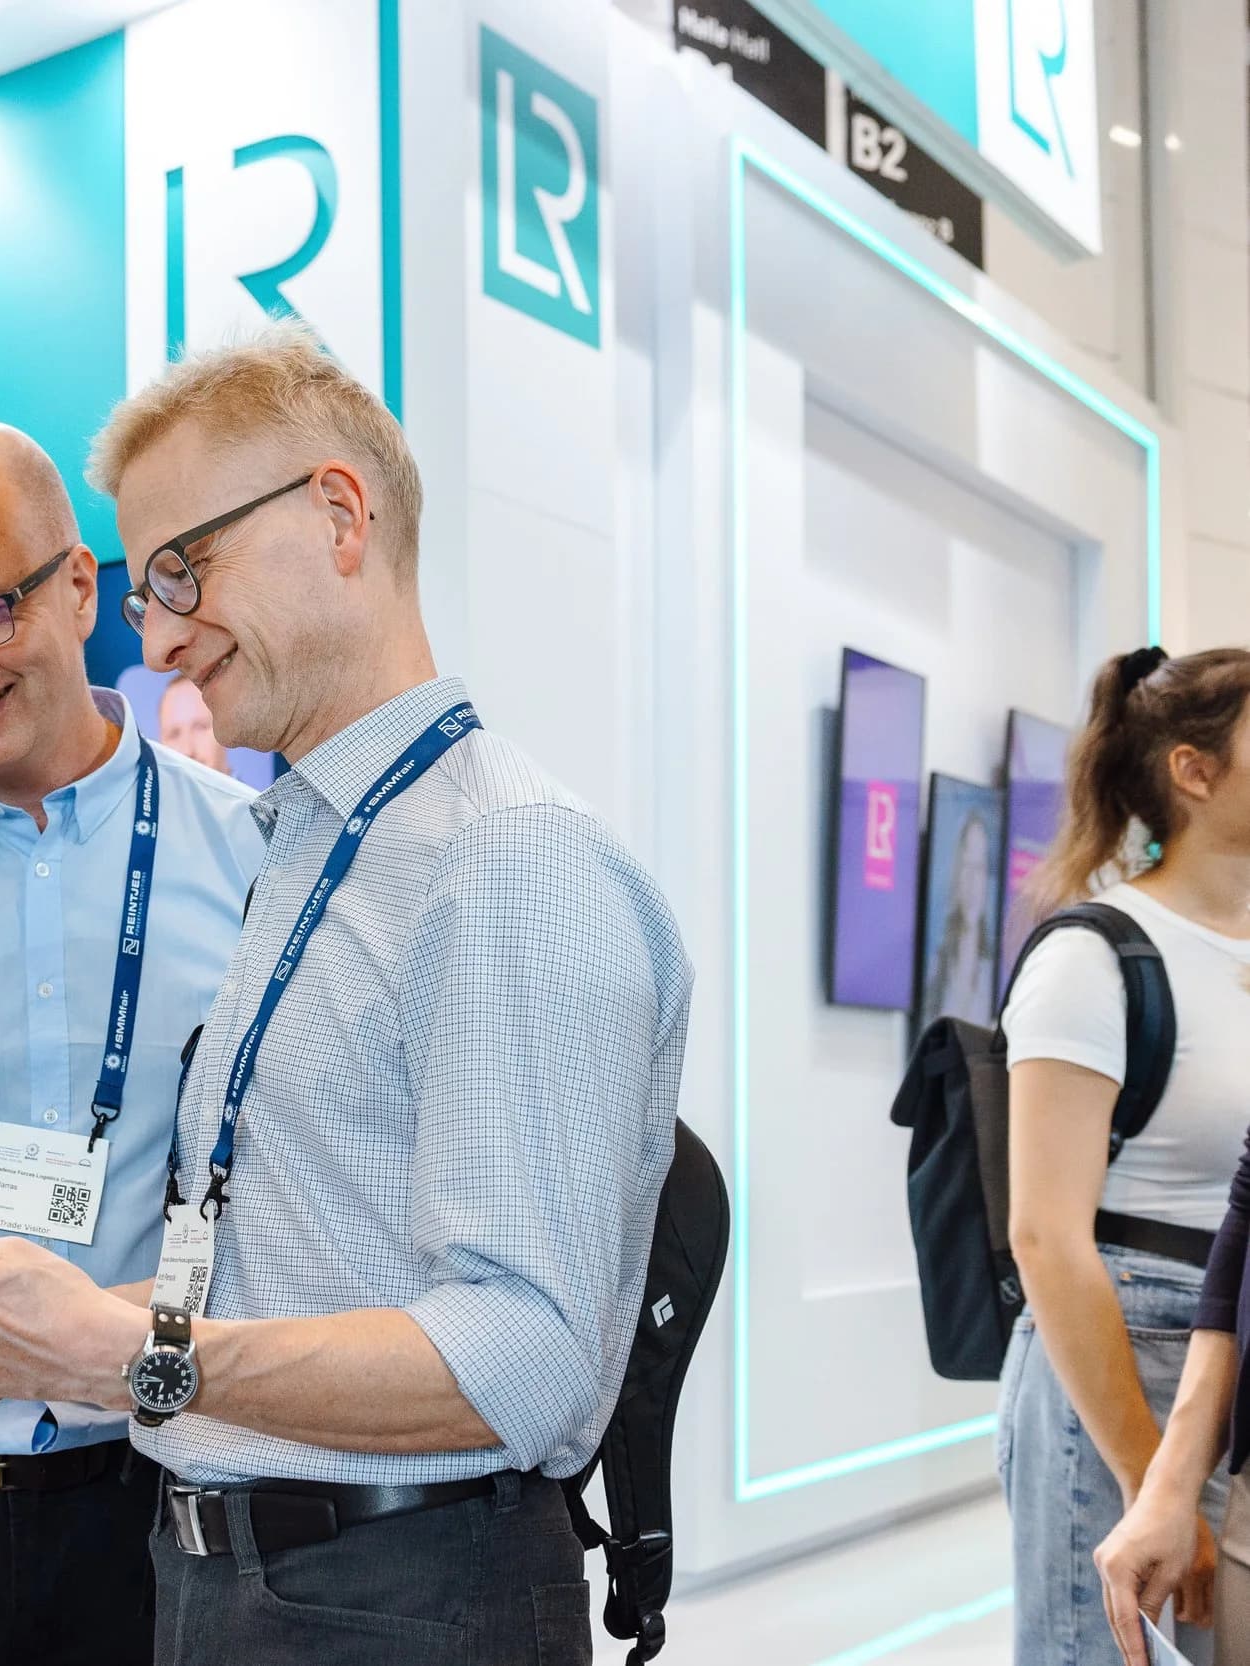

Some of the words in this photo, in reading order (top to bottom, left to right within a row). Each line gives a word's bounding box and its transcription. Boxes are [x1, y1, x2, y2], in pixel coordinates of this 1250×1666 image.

[851, 112, 908, 183] B2
[496, 68, 592, 316] LR
[364, 758, 416, 814] #SMMfair
[125, 870, 141, 936] REINTJES
[286, 877, 330, 957] REINTJES
[114, 989, 128, 1050] #SMMfair
[232, 1023, 260, 1099] #SMMfair
[0, 1219, 22, 1230] Trade
[24, 1223, 51, 1234] Visitor
